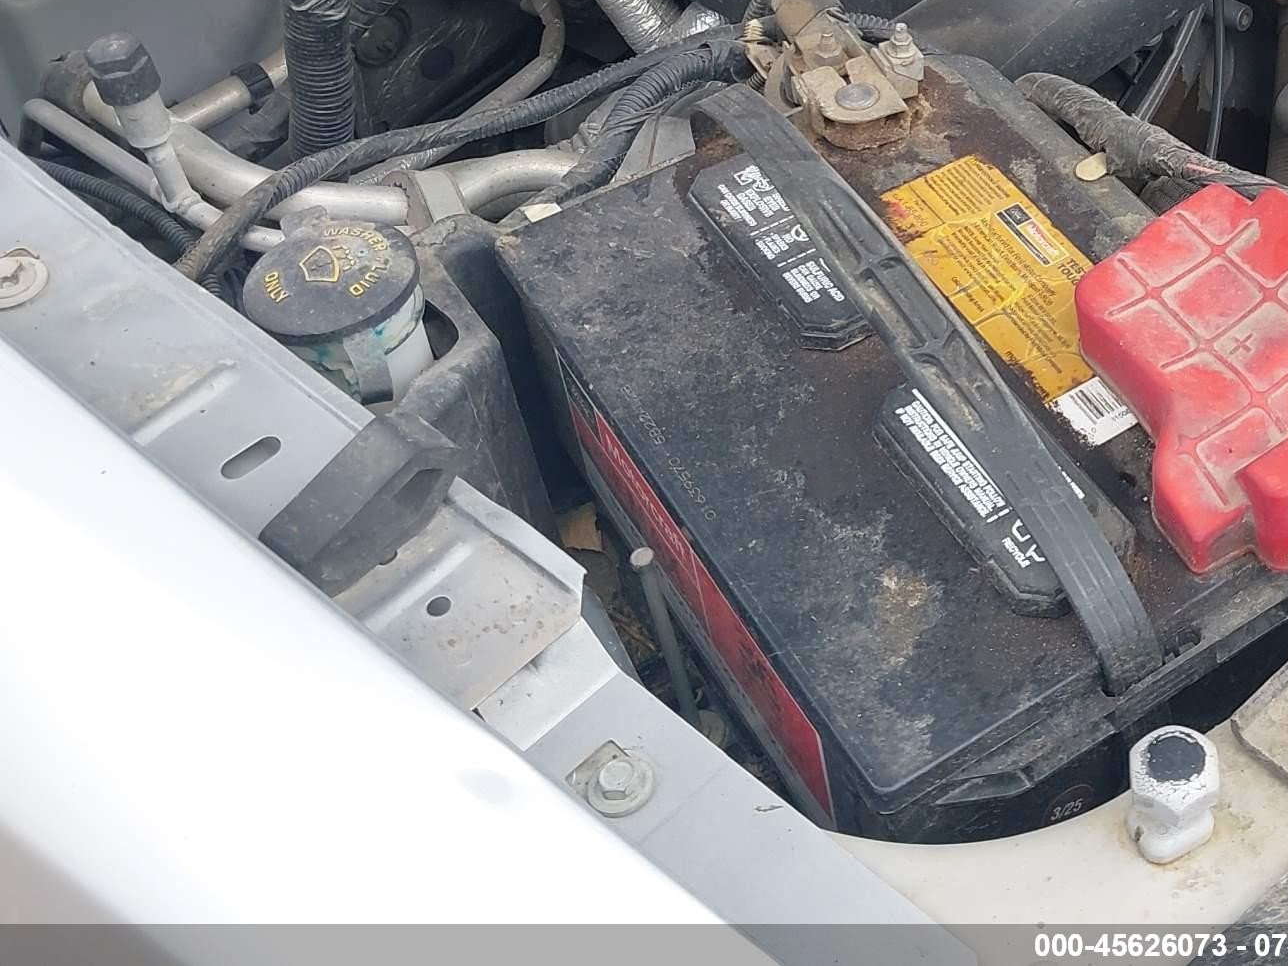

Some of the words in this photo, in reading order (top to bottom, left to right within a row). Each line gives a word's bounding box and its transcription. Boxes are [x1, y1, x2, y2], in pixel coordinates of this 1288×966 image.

[745, 188, 774, 217] EXPLOSIVE
[323, 226, 389, 252] WASHER
[781, 233, 794, 244] NO
[1027, 223, 1060, 257] Motorcraft
[263, 270, 290, 303] ONLY
[349, 257, 391, 297] FLUID
[805, 260, 834, 288] SULFURIC
[827, 286, 845, 301] ACID
[930, 423, 944, 435] FOR
[1001, 537, 1030, 567] RECYCLE
[1050, 797, 1084, 821] 3/25
